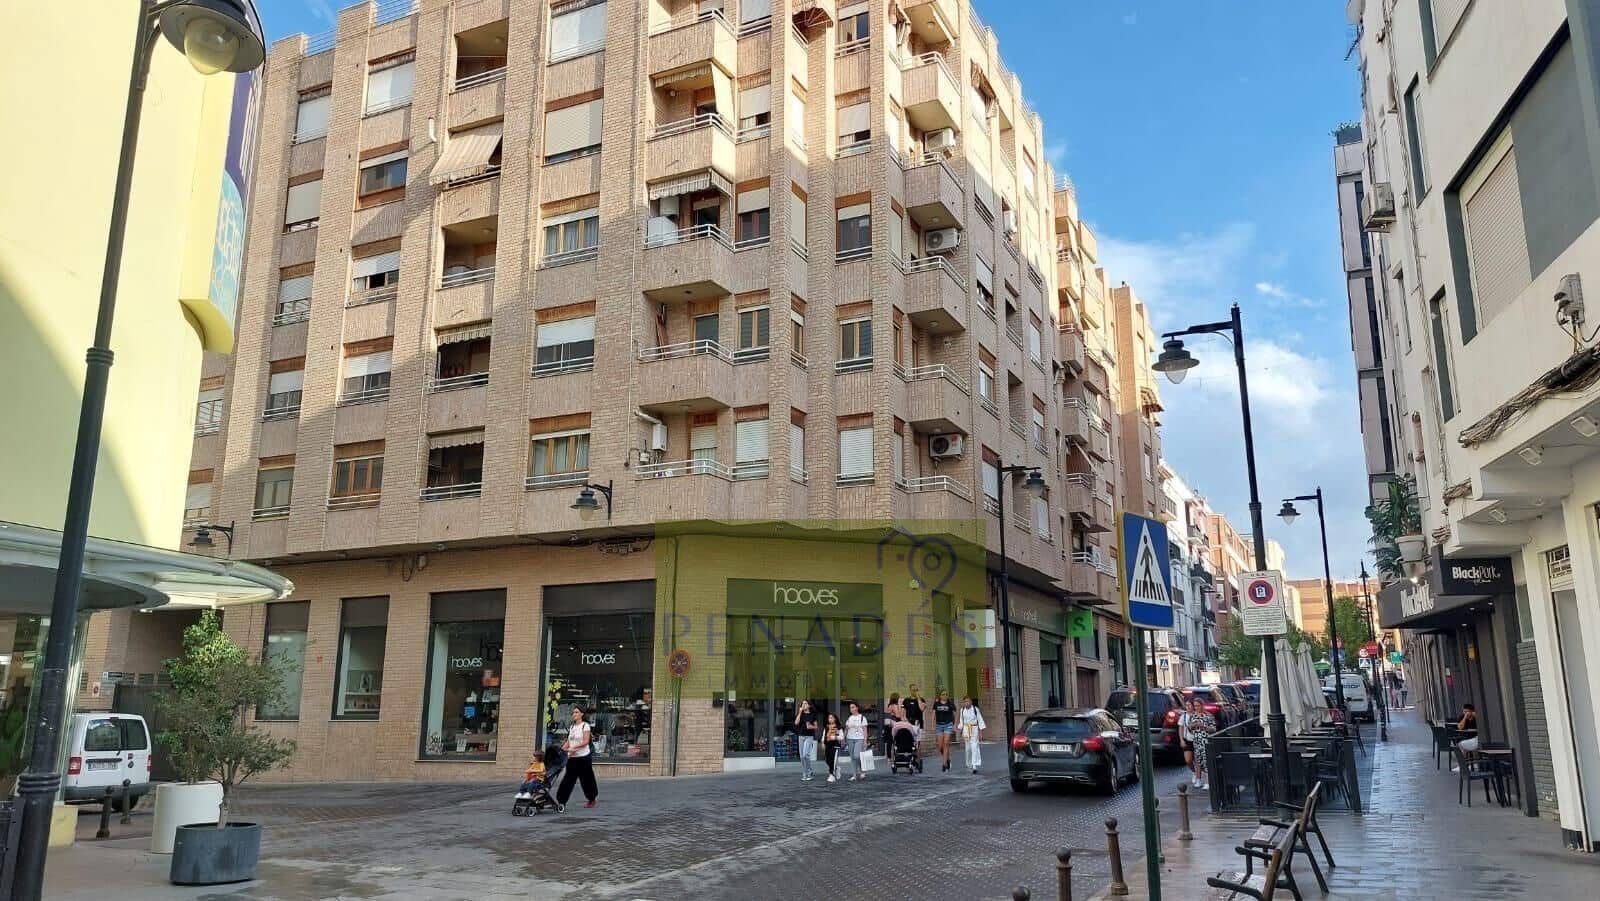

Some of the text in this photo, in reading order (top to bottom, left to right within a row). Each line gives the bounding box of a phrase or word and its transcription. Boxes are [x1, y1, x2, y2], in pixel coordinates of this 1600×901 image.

[773, 581, 839, 606] hooves
[1073, 616, 1087, 632] S
[451, 655, 484, 672] hooves
[581, 651, 616, 665] hooves
